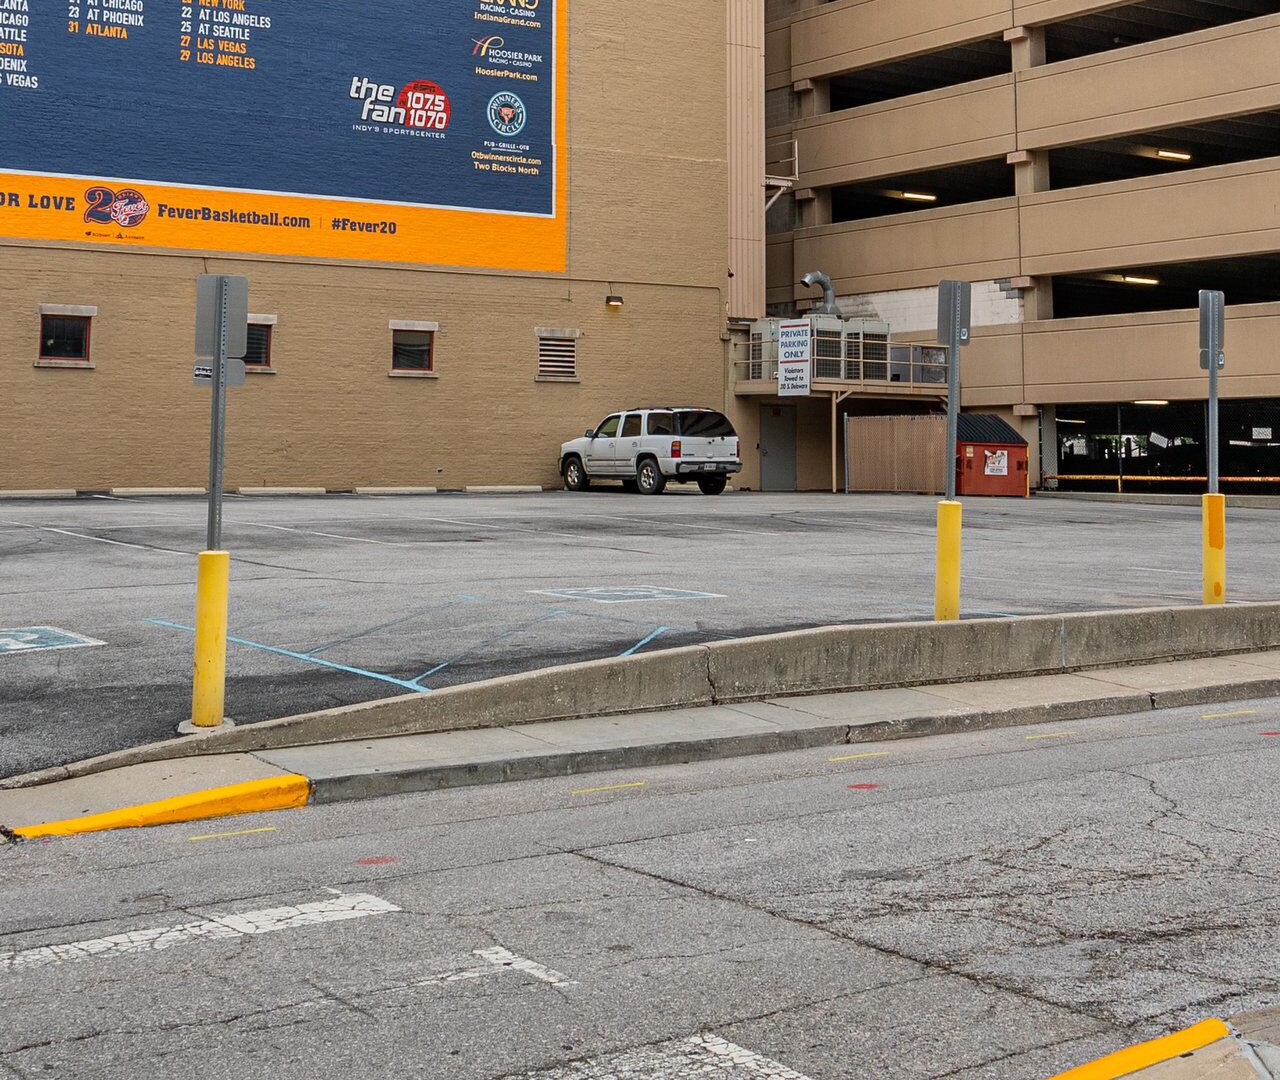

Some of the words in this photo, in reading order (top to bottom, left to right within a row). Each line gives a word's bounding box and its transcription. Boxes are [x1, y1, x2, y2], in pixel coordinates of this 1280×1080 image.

[68, 5, 80, 19] 23
[86, 8, 101, 21] AT
[102, 9, 145, 27] PHOENIX
[181, 5, 193, 19] 22
[198, 8, 211, 21] AT
[213, 9, 231, 24] LOS
[231, 12, 271, 29] ANGELES
[480, 3, 506, 14] RACING
[509, 7, 536, 18] CASINO
[474, 11, 541, 28] IndianaGrand.com
[67, 20, 79, 33] 31
[85, 23, 128, 39] ATLANTA
[180, 20, 192, 33] 25
[197, 22, 211, 36] AT
[212, 24, 250, 41] SEATTLE
[179, 34, 192, 47] 27
[197, 36, 215, 51] LAS
[217, 39, 247, 55] VEGAS
[179, 49, 191, 62] 29
[196, 51, 214, 65] LOS
[215, 54, 256, 70] ANGELES
[488, 48, 523, 60] HOOSIER
[524, 53, 543, 63] PARK
[5, 73, 39, 89] VEGAS
[475, 66, 538, 81] HoosierPark.com
[350, 76, 395, 102] the
[407, 91, 446, 111] 107.5
[361, 96, 407, 125] fan
[409, 109, 447, 130] 1070
[493, 118, 521, 133] CIRCLE
[352, 124, 380, 133] INDY'S
[383, 126, 446, 139] SPORTSCENTER
[473, 161, 491, 171] Two
[491, 163, 517, 173] Blocks
[518, 166, 539, 175] North
[27, 194, 76, 211] LOVE
[157, 203, 311, 228] FeverBasketball.com
[331, 217, 397, 235] #Fever20
[780, 329, 809, 338] PRIVATE
[780, 339, 808, 349] PARKING
[783, 350, 805, 359] ONLY
